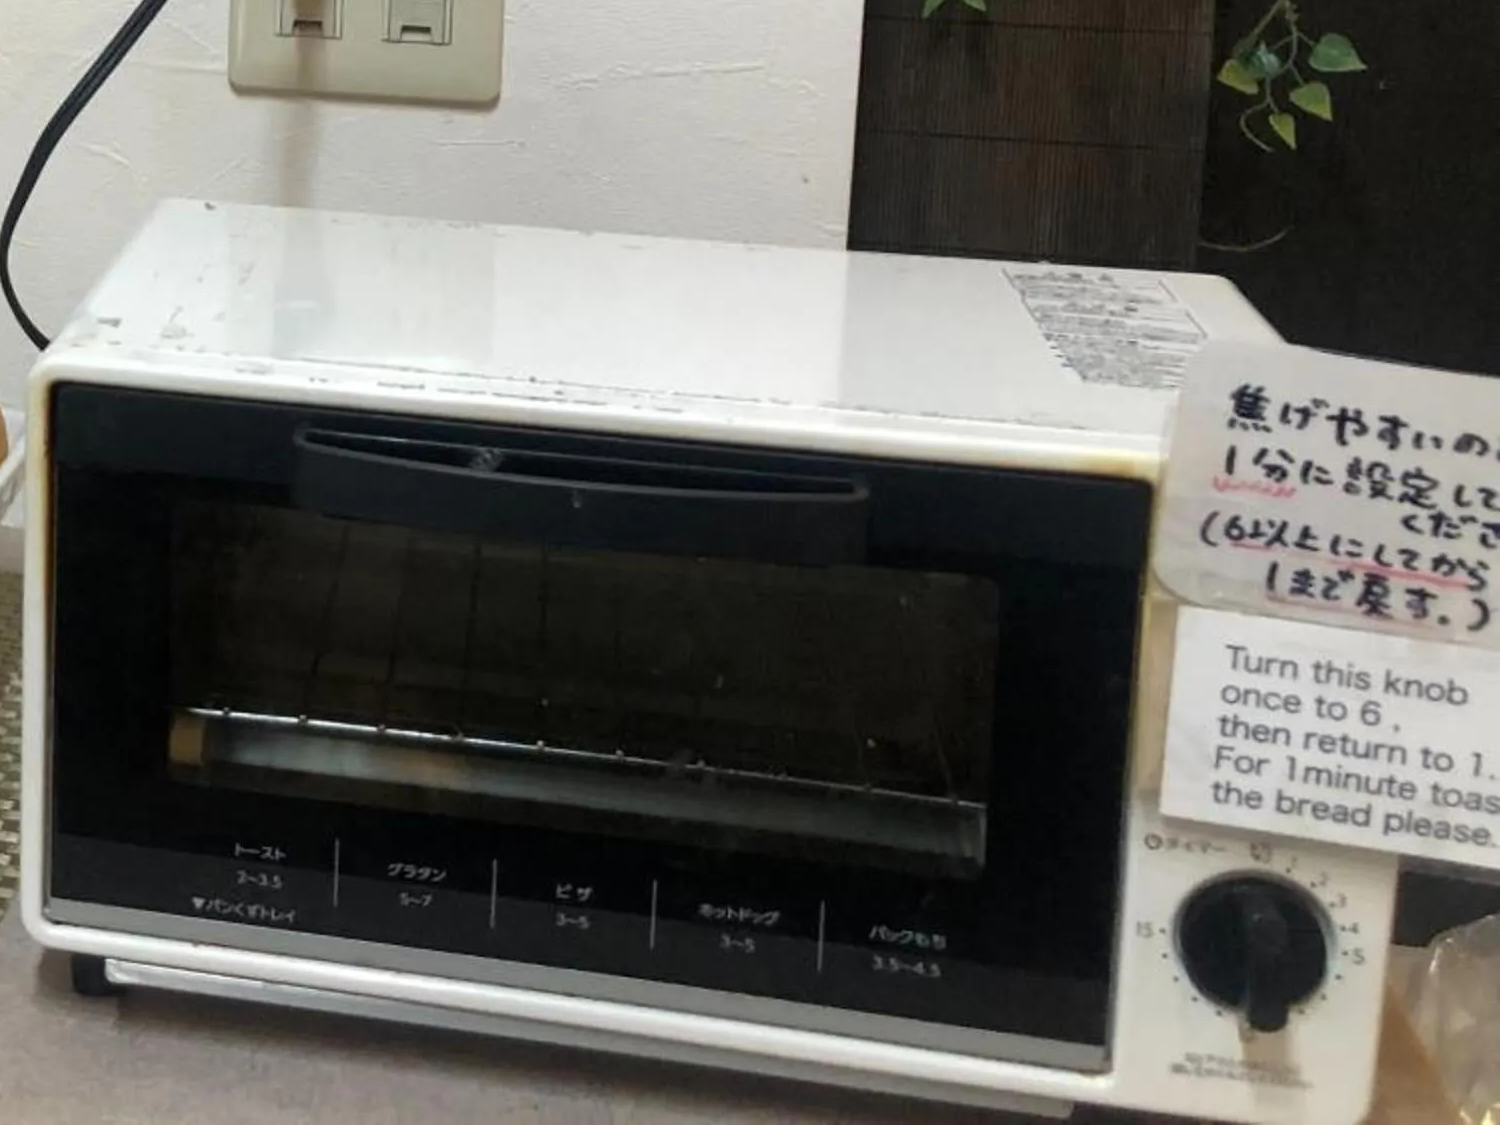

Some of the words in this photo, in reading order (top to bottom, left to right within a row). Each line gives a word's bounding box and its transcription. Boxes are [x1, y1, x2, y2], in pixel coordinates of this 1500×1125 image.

[1228, 384, 1500, 463] 焦げやすいの
[1225, 644, 1298, 681] Turn
[1312, 661, 1371, 691] this
[1384, 670, 1469, 706] knob
[1220, 684, 1301, 714] once
[1315, 697, 1348, 722] to
[1214, 745, 1270, 775] For
[1218, 715, 1291, 747] then
[1303, 731, 1408, 766] return
[1421, 747, 1454, 773] to
[1472, 752, 1496, 781] 1.
[1211, 781, 1263, 810] the
[1275, 789, 1372, 827] bread
[1383, 810, 1497, 849] please.
[235, 842, 286, 861] トースト
[387, 862, 446, 882] グラタン
